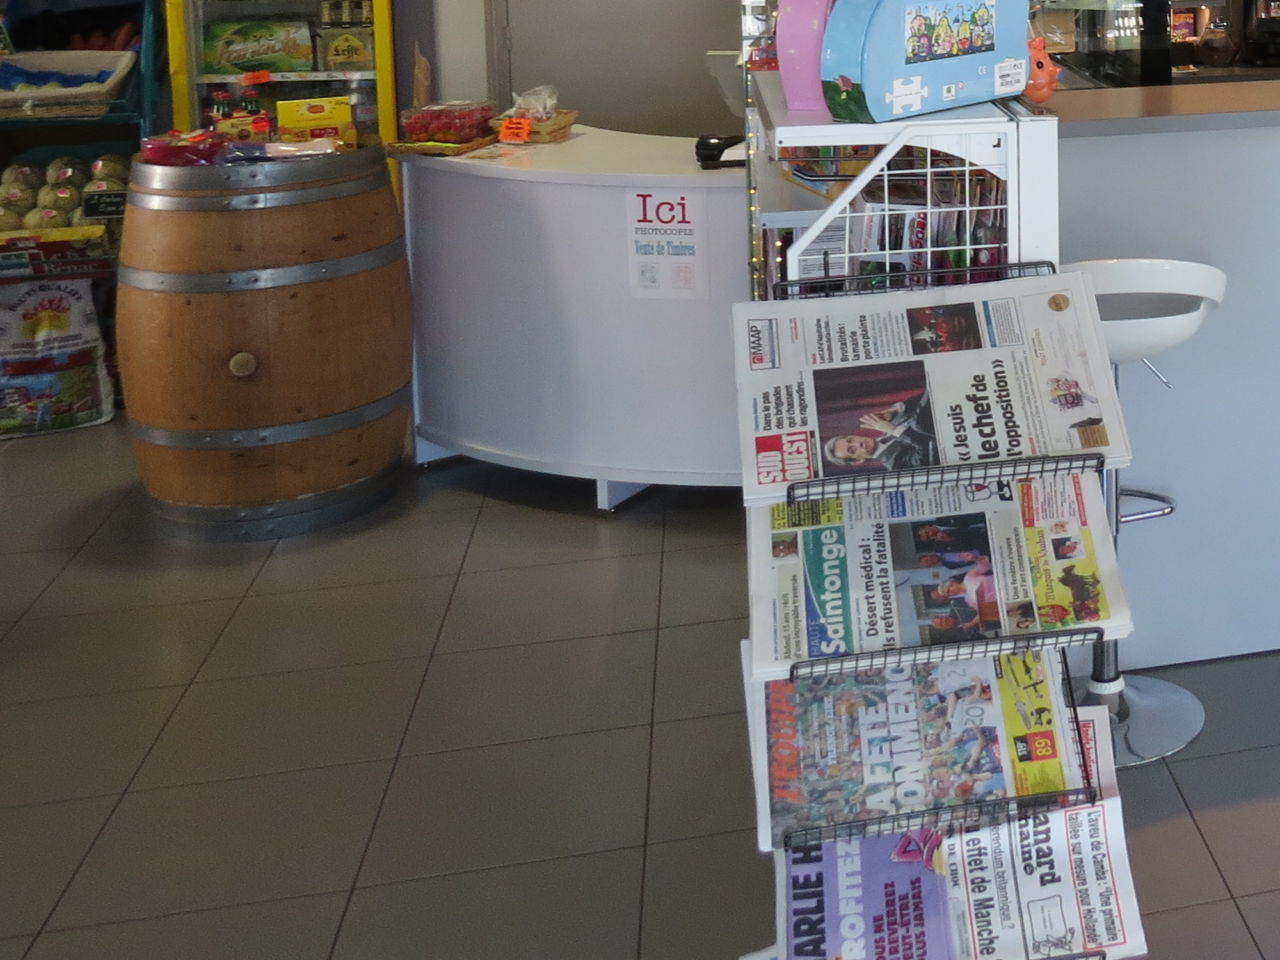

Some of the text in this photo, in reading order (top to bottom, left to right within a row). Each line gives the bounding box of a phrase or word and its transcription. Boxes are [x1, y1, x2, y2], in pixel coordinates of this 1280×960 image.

[636, 194, 691, 224] Ici
[750, 326, 762, 355] MAAP
[836, 327, 849, 362] Brutalités
[849, 331, 860, 353] mairie
[859, 315, 873, 360] porte plainte
[762, 392, 772, 404] pas
[970, 374, 987, 392] de
[763, 413, 772, 431] Dans
[772, 386, 784, 429] des brigades
[784, 384, 796, 428] qui chassent
[799, 416, 808, 426] les
[758, 451, 783, 484] SUD
[782, 433, 809, 480] OUEST
[873, 523, 887, 564] fatalité
[858, 544, 874, 592] médical
[877, 568, 889, 578] la
[1007, 561, 1017, 585] fenêtre
[820, 529, 846, 654] Saintonge
[877, 581, 894, 633] refusent
[1011, 586, 1019, 600] Une
[865, 593, 878, 636] Désert
[809, 619, 820, 655] HAUTE
[963, 706, 984, 726] 20
[1068, 812, 1084, 839] taillée
[1087, 810, 1102, 839] L'aveu
[947, 843, 957, 859] DE
[992, 827, 1004, 869] érendum
[1032, 813, 1062, 887] anard
[1071, 842, 1081, 855] sur
[1090, 841, 1104, 851] de
[1074, 858, 1087, 886] mesure
[1092, 853, 1108, 881] Camba
[836, 839, 866, 960] ROFITEZ
[910, 877, 924, 928] JAMAIS
[966, 838, 1000, 956] effet de Manche
[996, 870, 1012, 920] britannique
[1077, 888, 1092, 906] pour
[884, 881, 900, 955] REVERREZ
[1101, 908, 1120, 942] primaire
